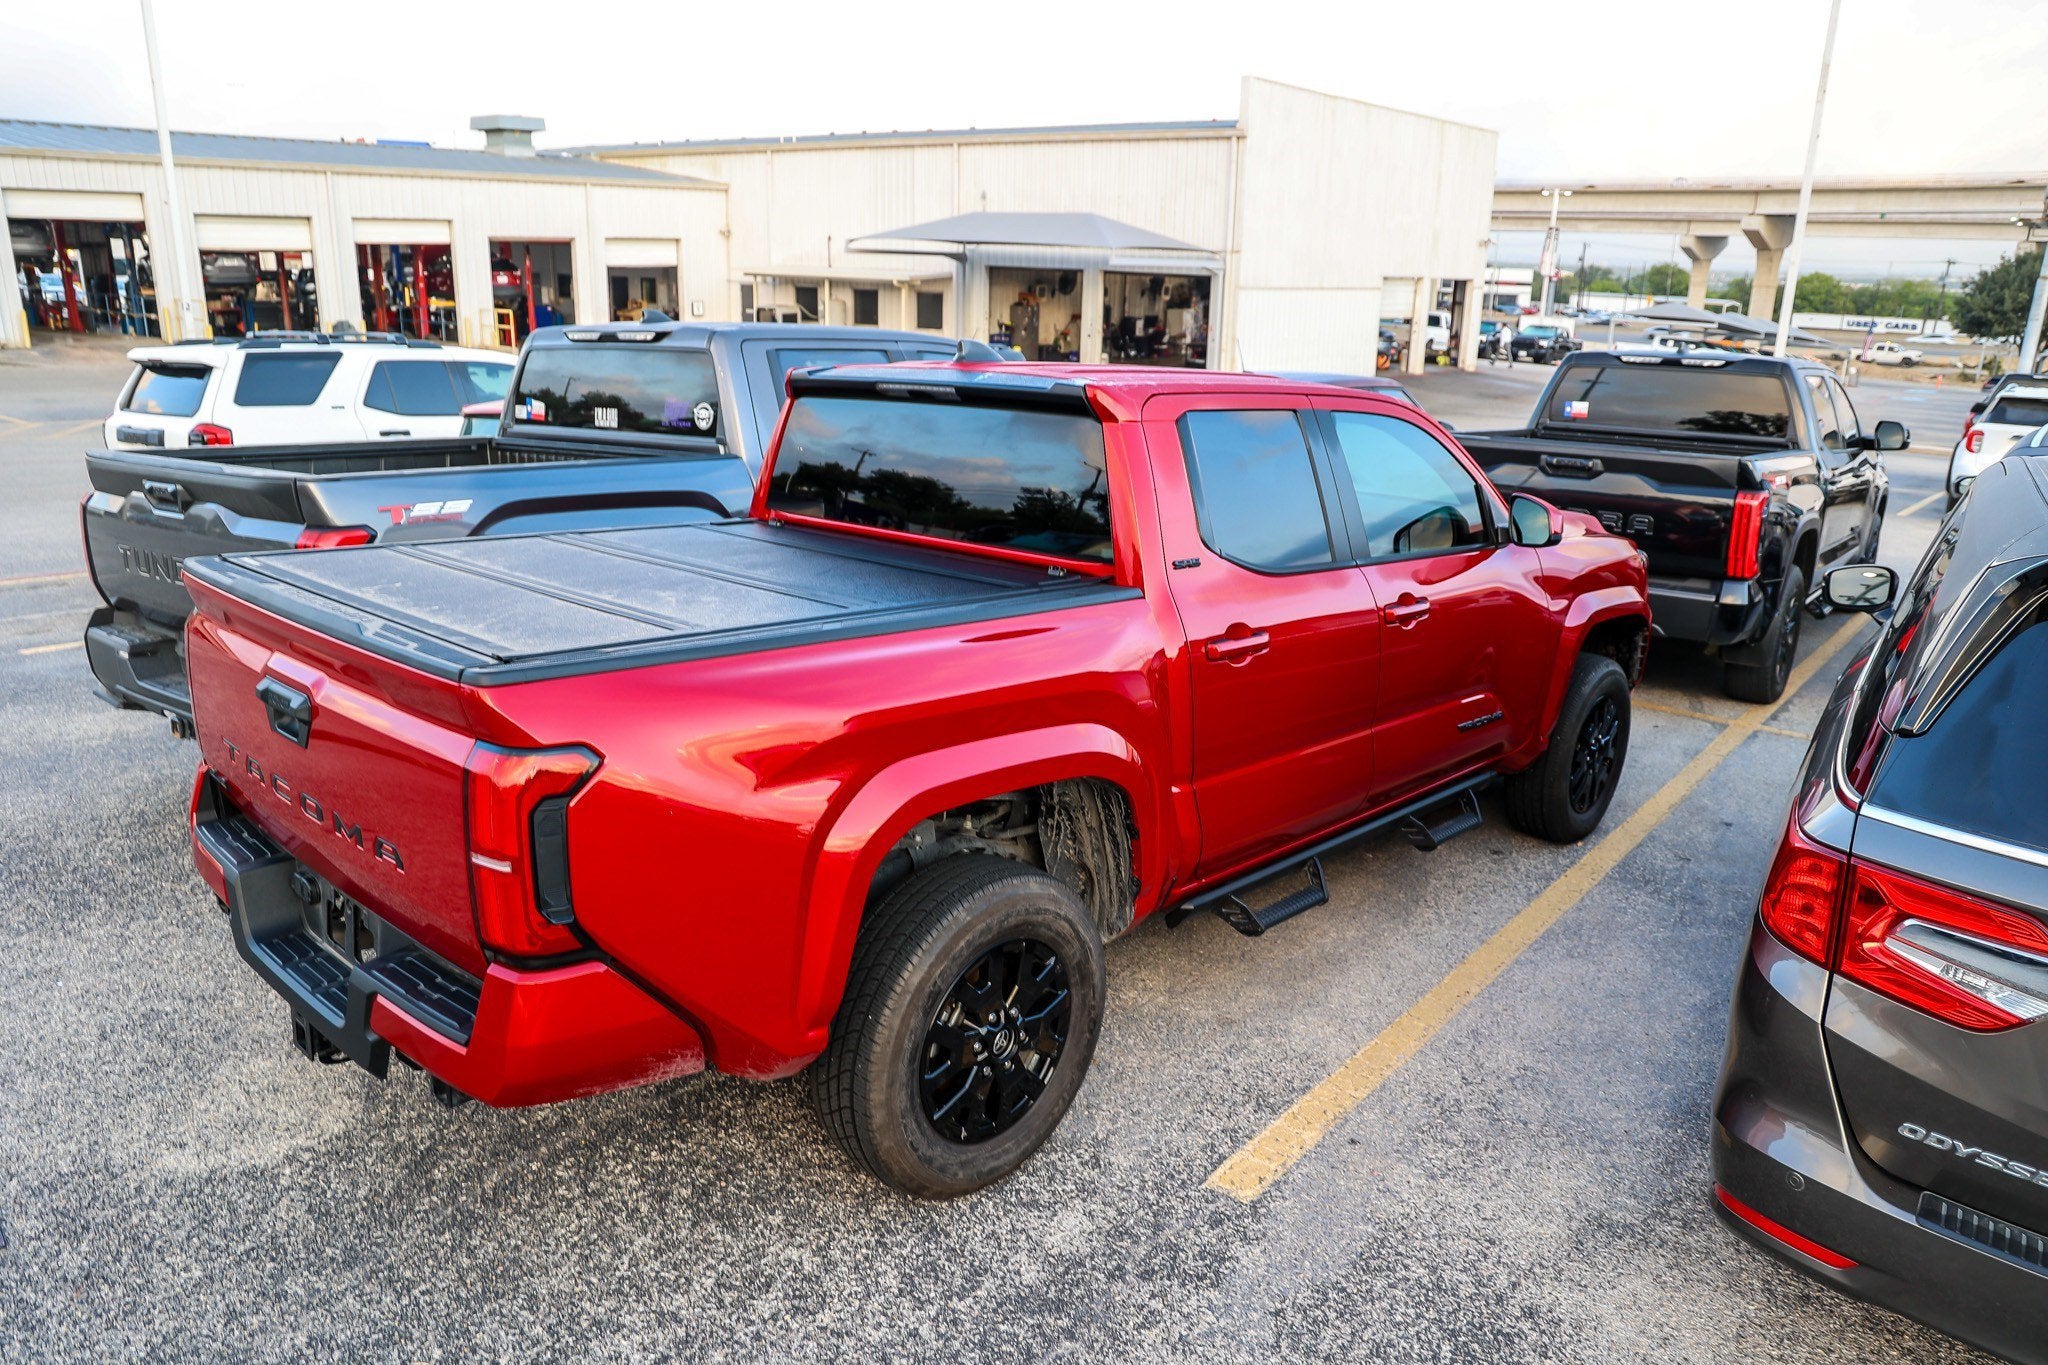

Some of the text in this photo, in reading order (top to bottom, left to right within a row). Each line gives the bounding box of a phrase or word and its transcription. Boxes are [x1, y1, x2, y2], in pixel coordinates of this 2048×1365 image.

[1846, 320, 1917, 330] USED CARS
[221, 736, 406, 875] TACOMA
